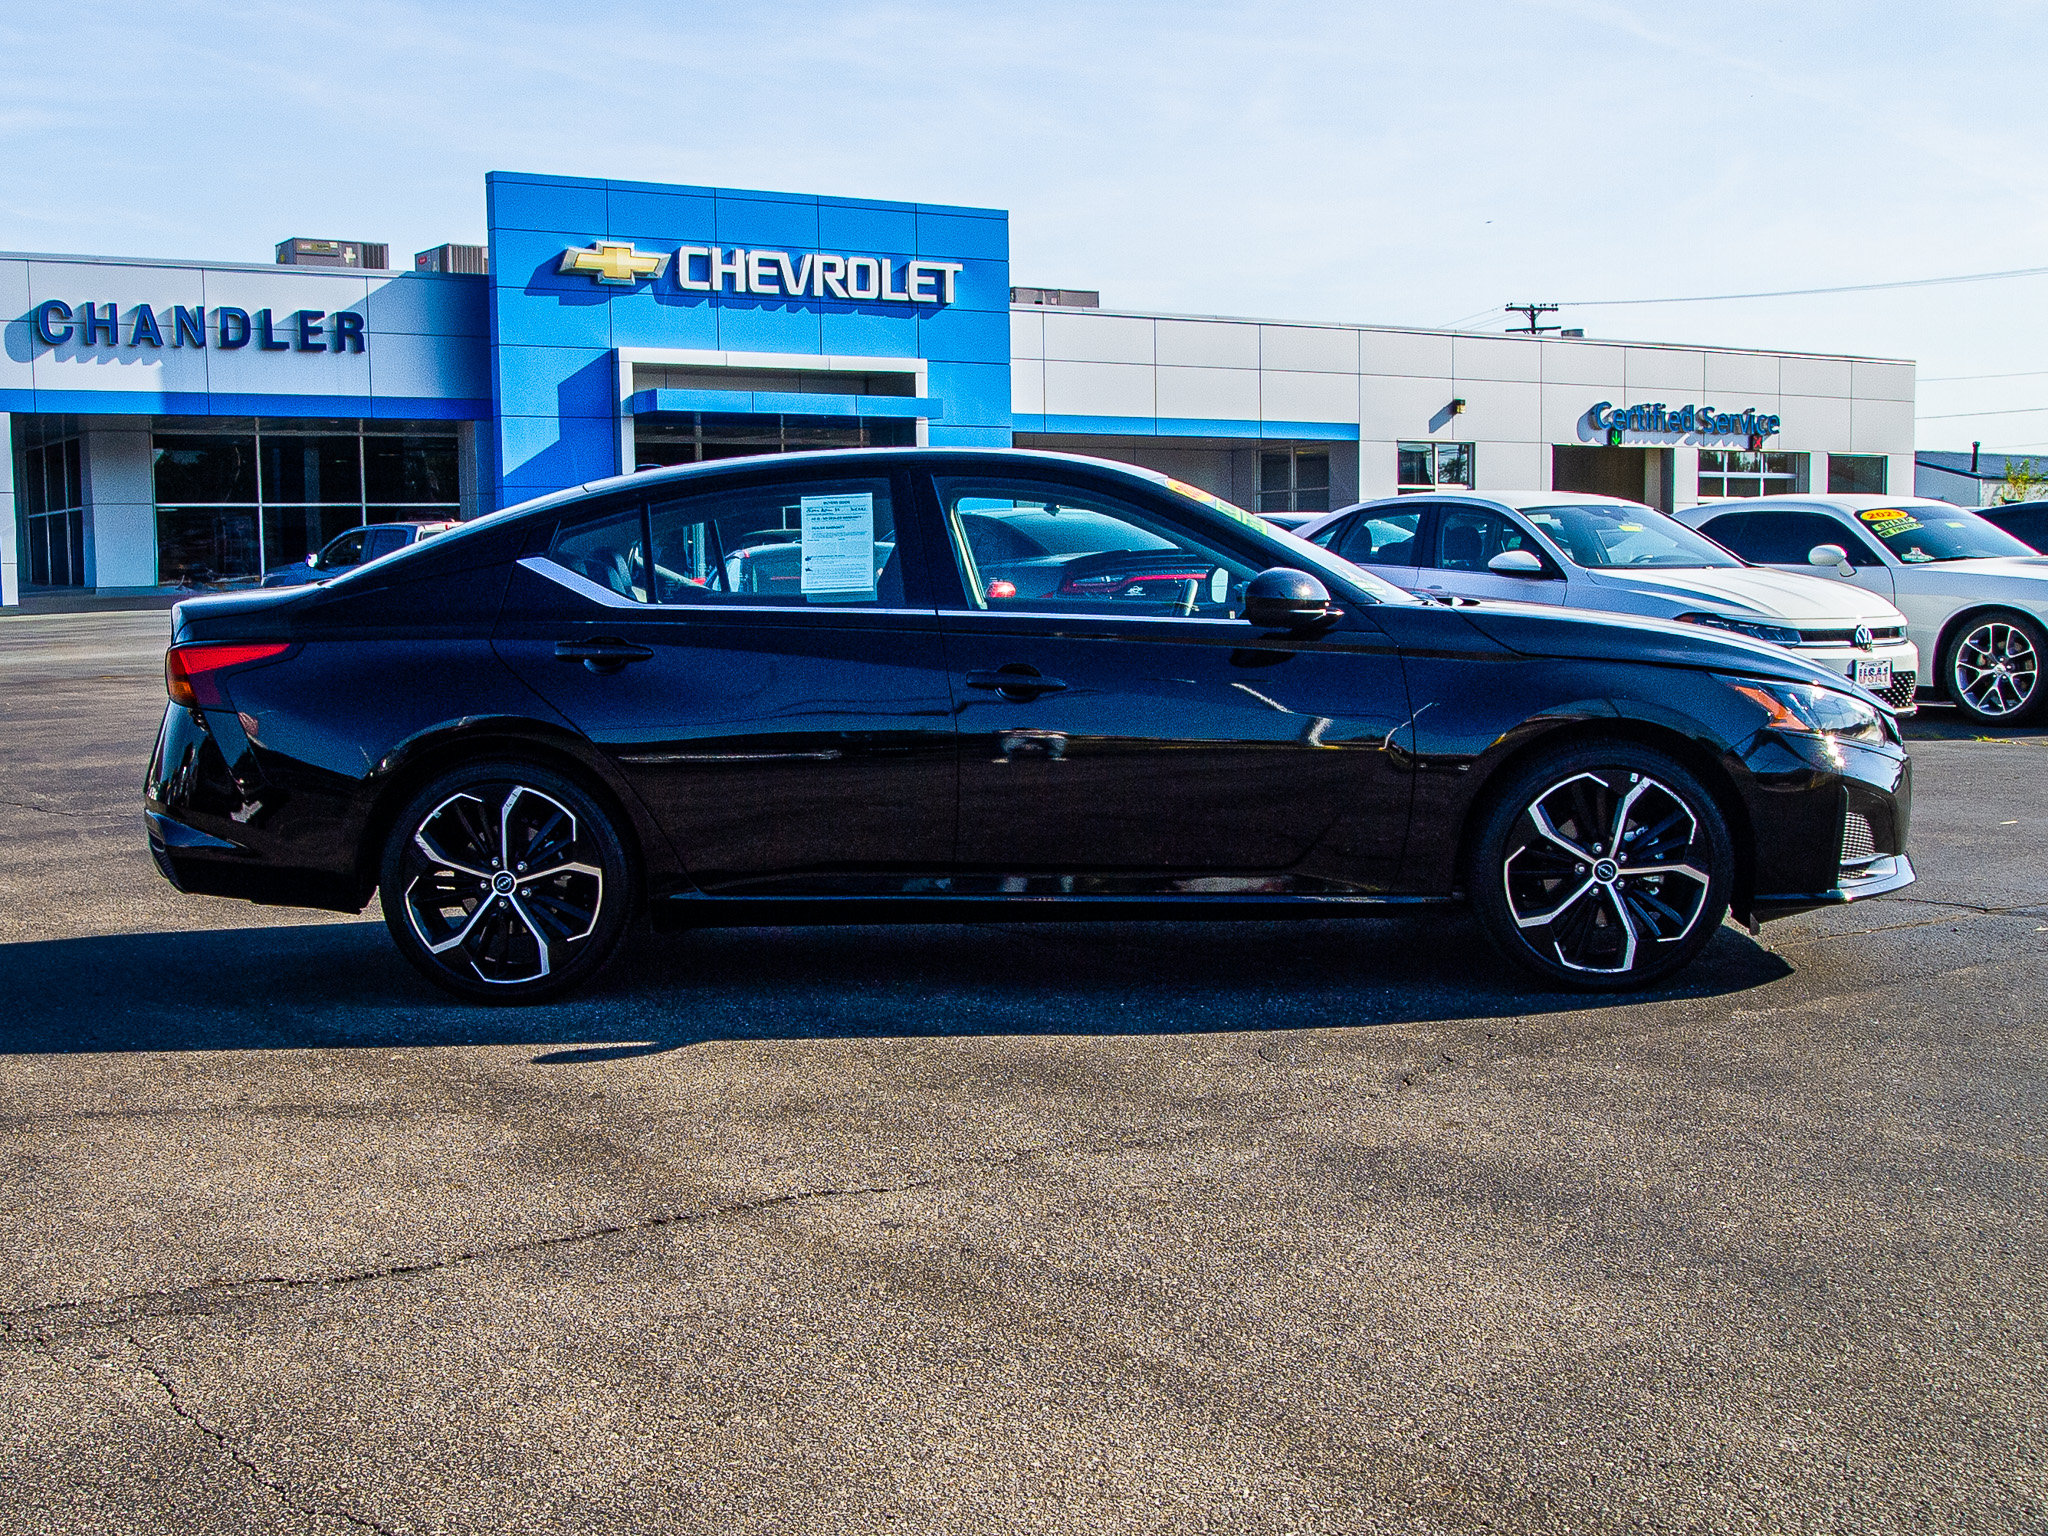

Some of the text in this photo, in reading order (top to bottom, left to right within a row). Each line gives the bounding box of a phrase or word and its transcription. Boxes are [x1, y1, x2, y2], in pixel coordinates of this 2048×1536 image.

[678, 246, 963, 304] CHEVROLET
[38, 299, 366, 353] CHANDLER
[1594, 401, 1781, 435] Certified Service
